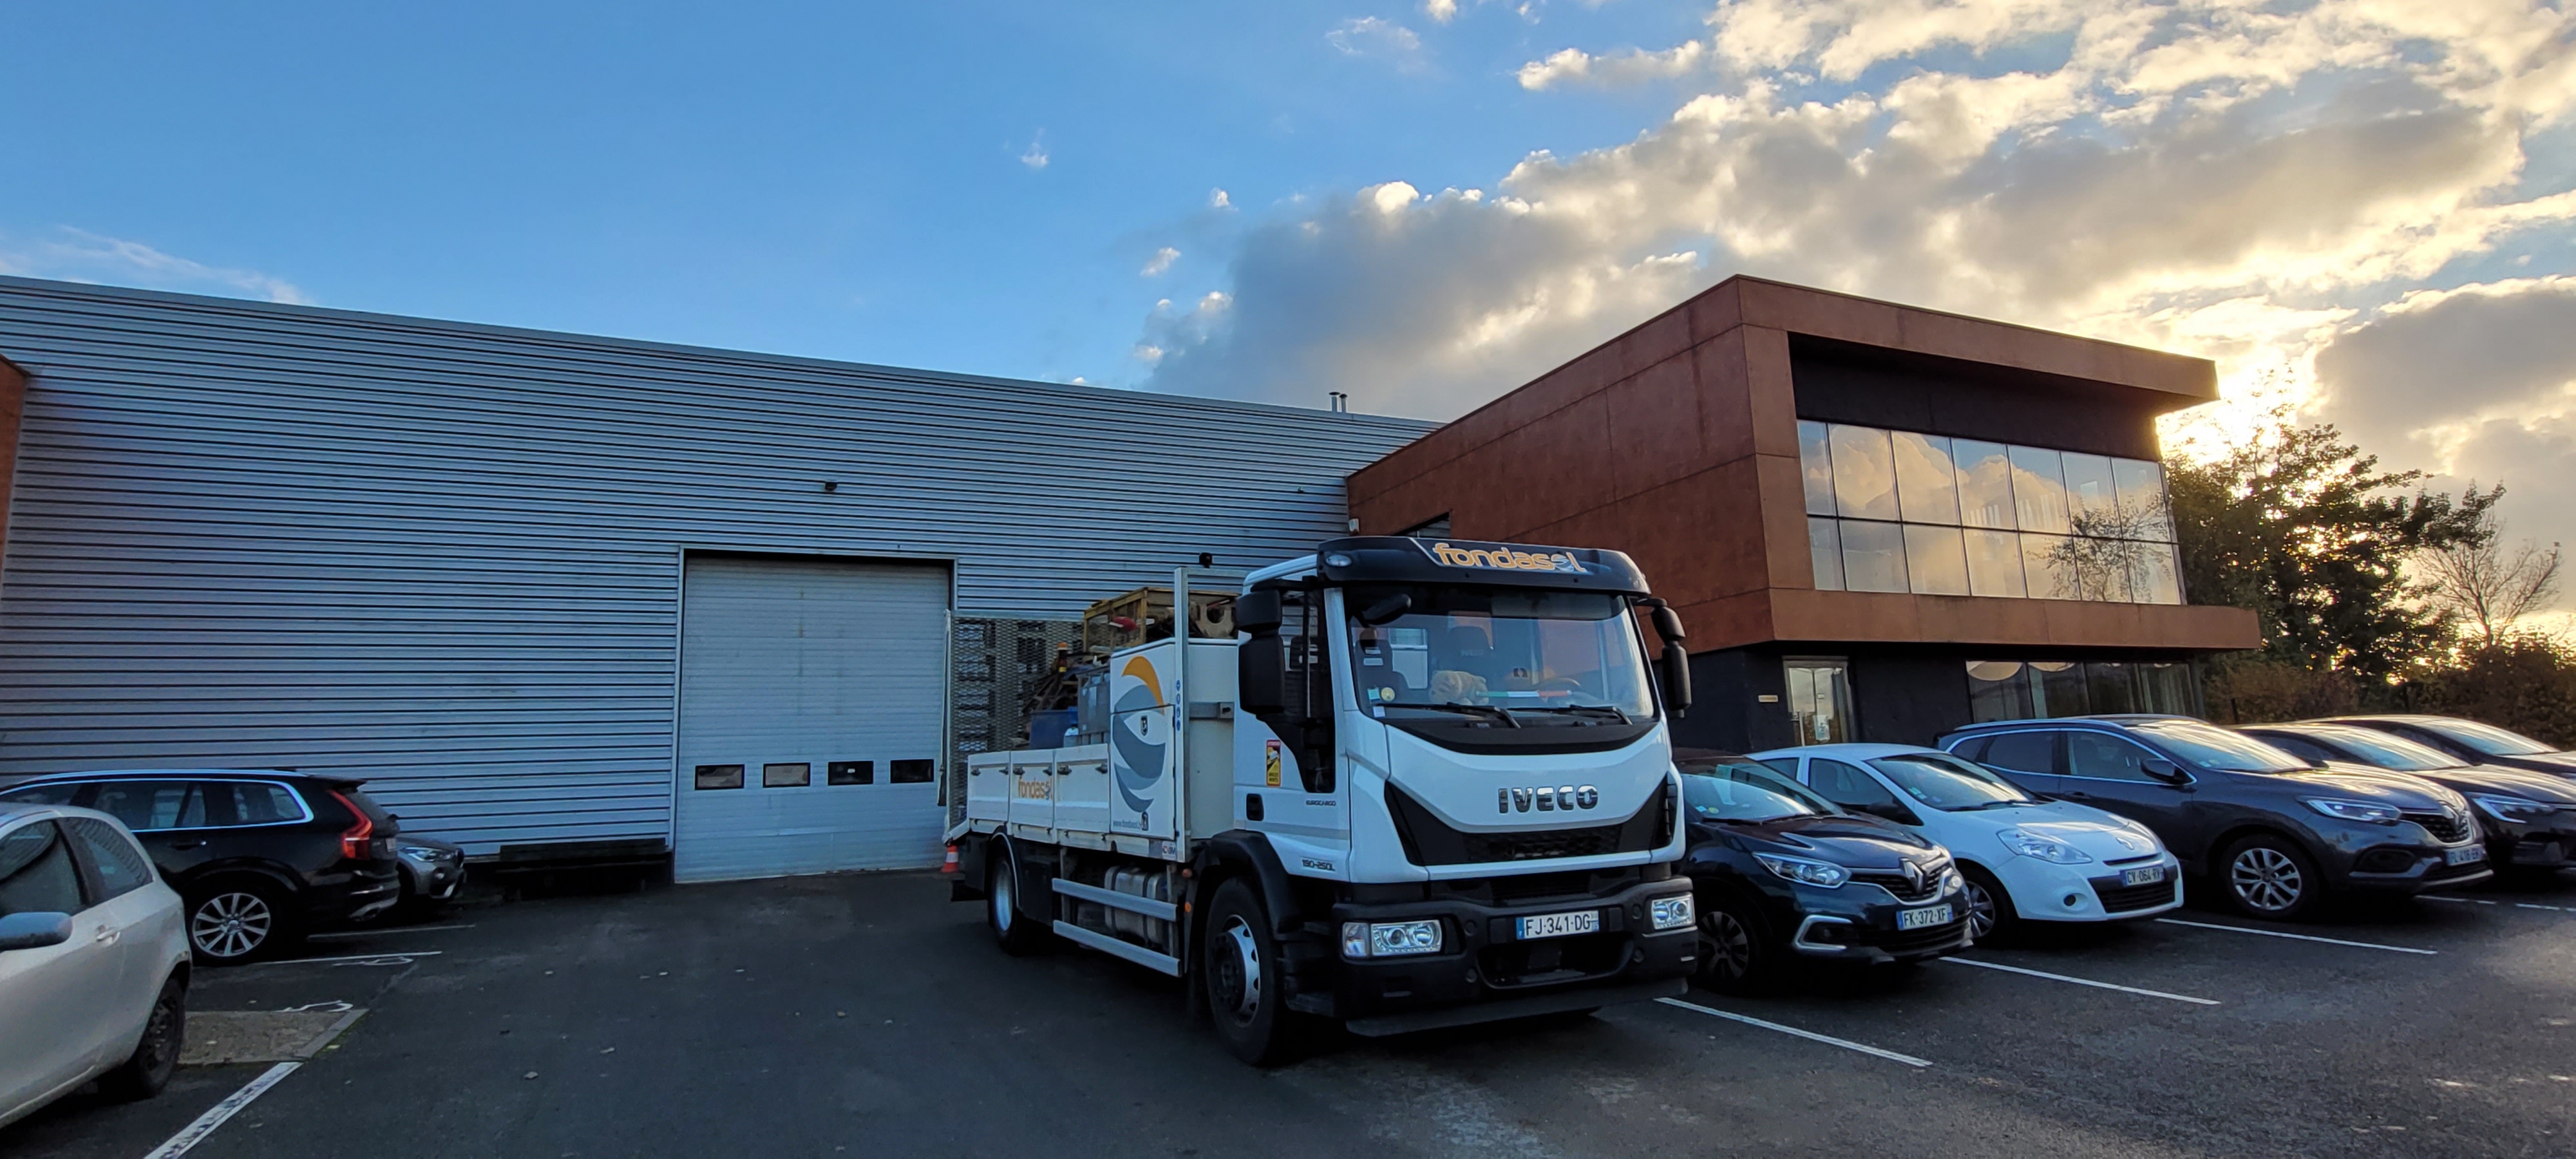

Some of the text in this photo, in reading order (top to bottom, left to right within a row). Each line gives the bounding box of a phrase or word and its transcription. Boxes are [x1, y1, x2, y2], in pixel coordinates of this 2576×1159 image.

[1432, 542, 1587, 572] fondasol
[1018, 776, 1053, 800] fondasol
[1498, 784, 1598, 813] IVECO
[1526, 914, 1591, 936] FJ-341-DG
[1904, 907, 1946, 927] FK-372-XF
